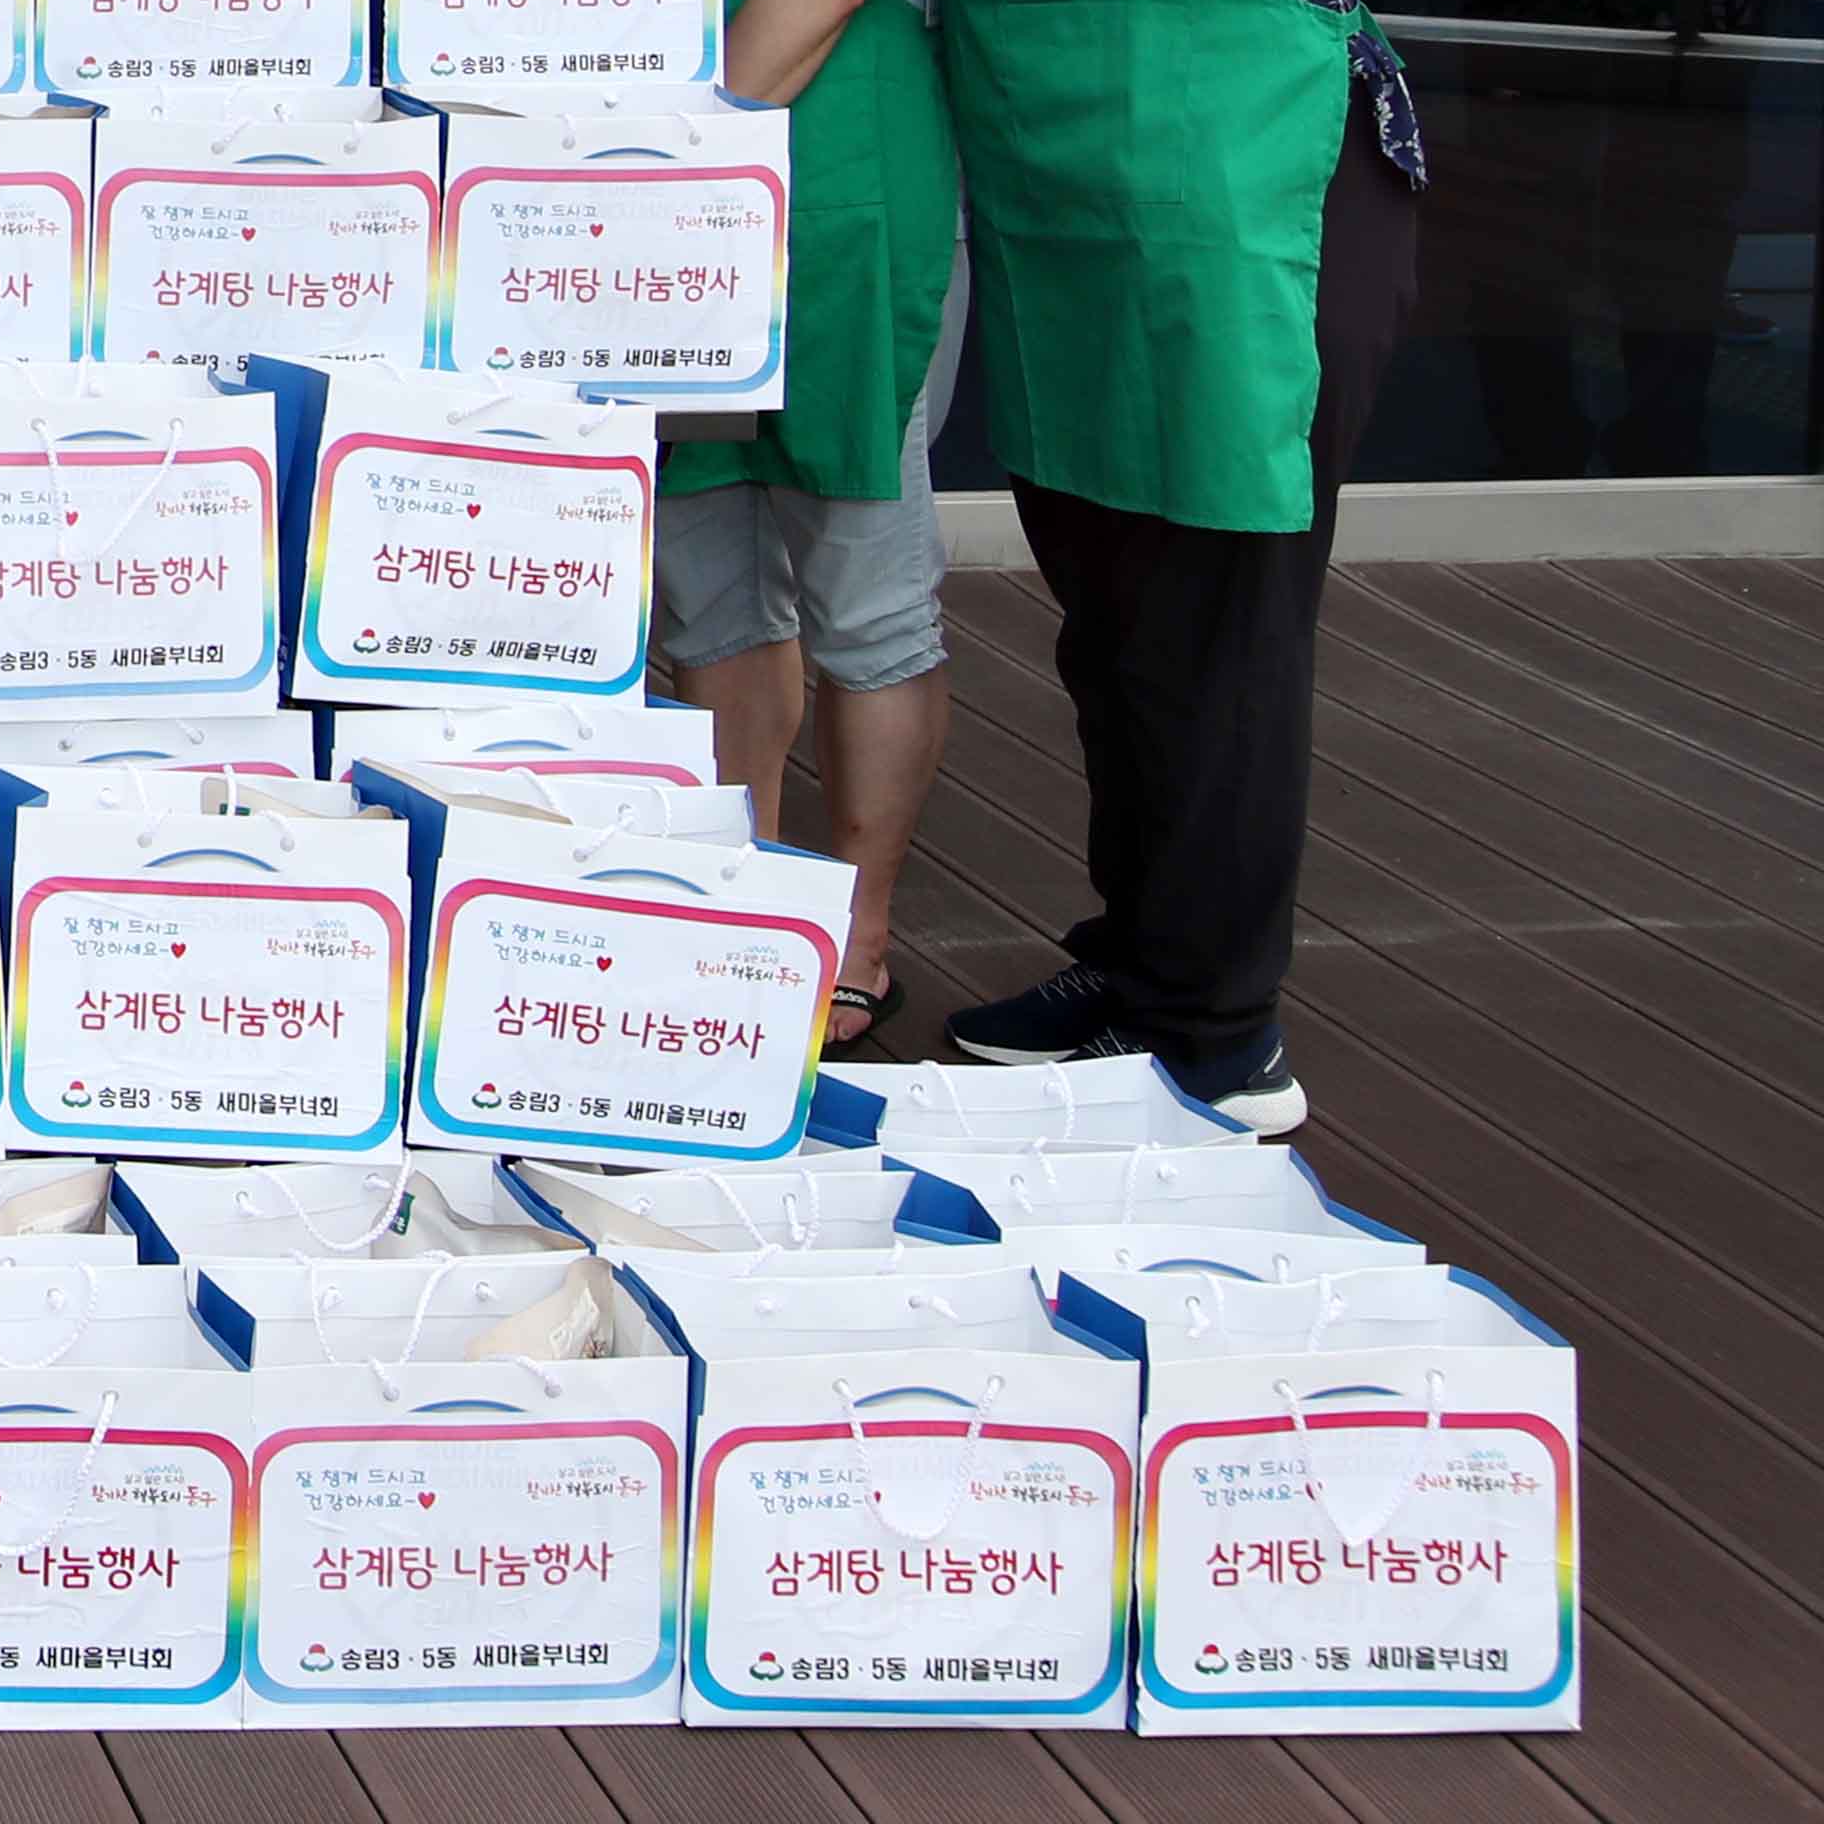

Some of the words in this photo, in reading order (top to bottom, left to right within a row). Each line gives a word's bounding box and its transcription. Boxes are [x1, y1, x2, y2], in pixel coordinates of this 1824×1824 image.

[152, 271, 254, 308] 삼계탕
[266, 272, 393, 309] 나눔행사
[502, 268, 600, 304] 삼계탕
[613, 267, 738, 303] 나눔행사
[94, 558, 230, 596] 나눔행사
[371, 546, 477, 590] 삼계탕
[488, 559, 615, 598] 나눔행사
[75, 991, 185, 1035] 삼계탕
[199, 997, 346, 1040] 나눔행사
[494, 995, 606, 1045] 삼계탕
[619, 1011, 765, 1057] 나눔행사
[16, 1545, 179, 1591] 나눔행사
[312, 1546, 439, 1591] 삼계탕
[453, 1542, 614, 1588] 나눔행사
[766, 1549, 887, 1597] 삼계탕
[898, 1548, 1066, 1597] 나눔행사
[1205, 1538, 1326, 1588] 삼계탕
[1341, 1537, 1508, 1585] 나눔행사
[35, 1646, 172, 1670] 새마을부녀회
[1367, 1646, 1508, 1673] 새마을부녀회
